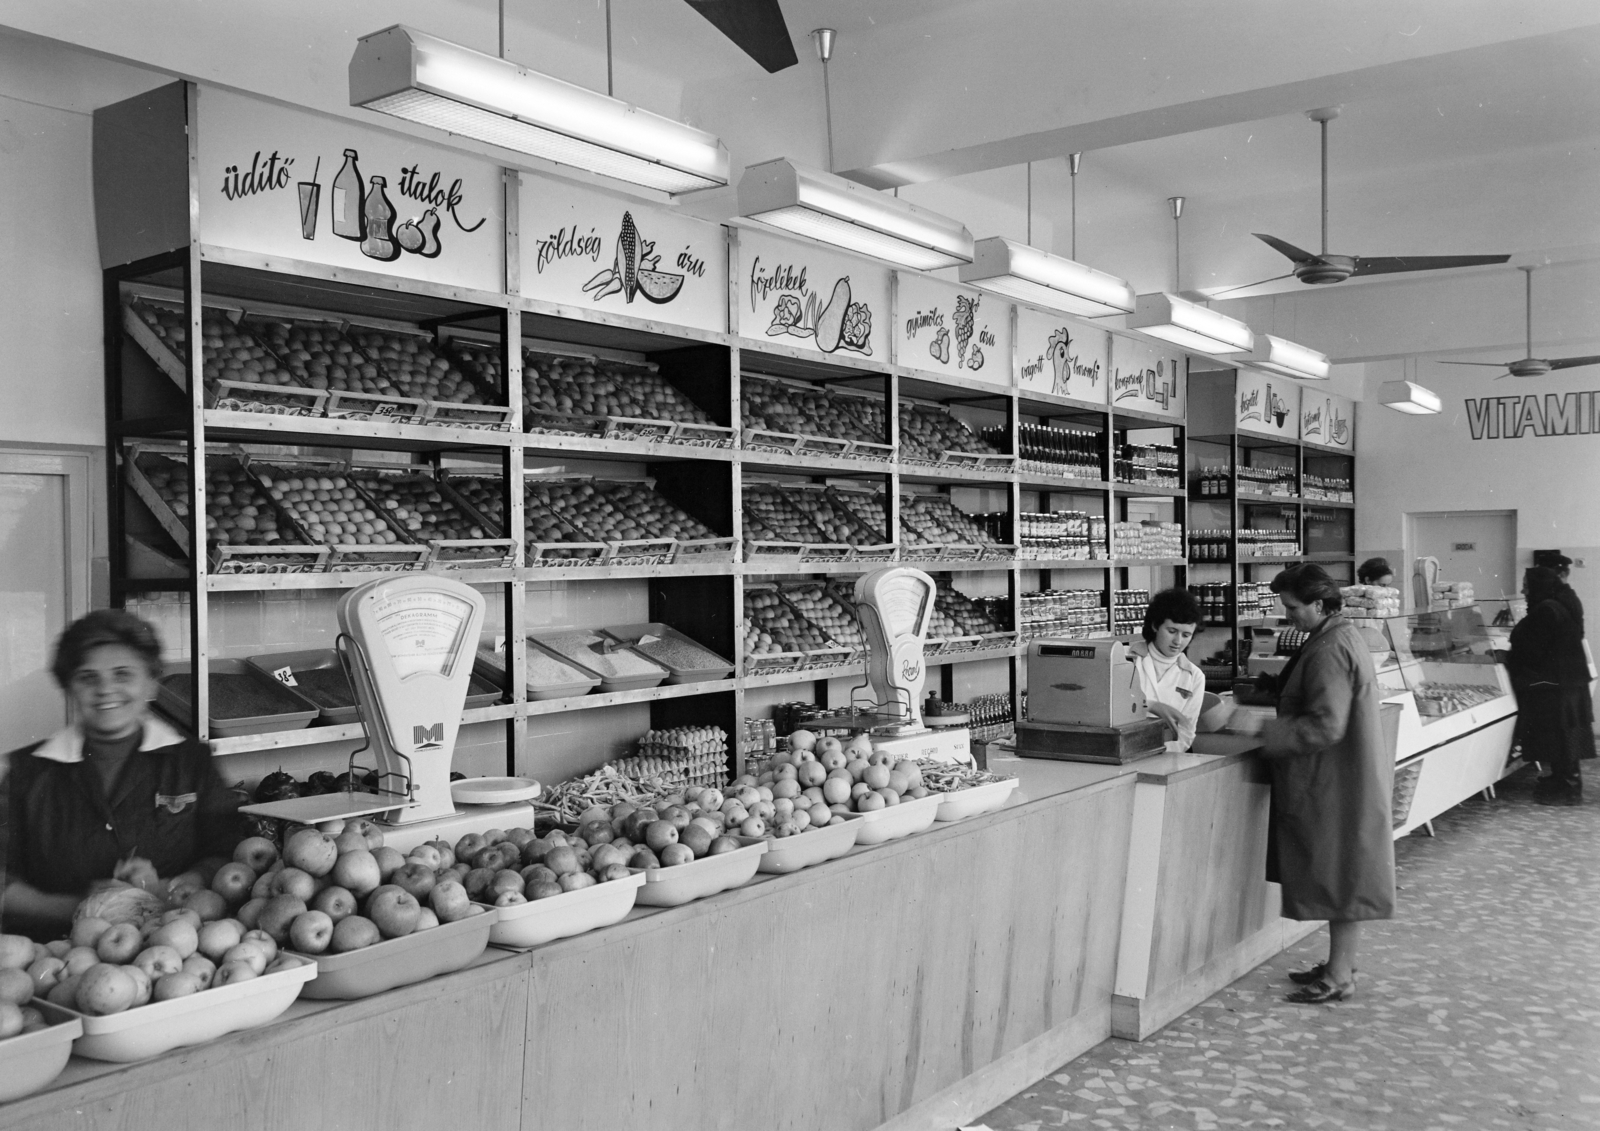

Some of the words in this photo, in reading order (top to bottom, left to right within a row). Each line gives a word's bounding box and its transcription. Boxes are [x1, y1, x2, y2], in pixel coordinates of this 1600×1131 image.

[221, 151, 295, 201] üdítő
[398, 164, 486, 232] italok
[536, 225, 602, 274] zöldség
[677, 245, 706, 278] áru
[751, 256, 808, 313] főzelékek
[906, 307, 944, 340] gyümölcs
[979, 324, 996, 347] áru
[1021, 354, 1045, 381] vágott
[1073, 354, 1101, 387] baromfi
[1455, 543, 1474, 551] IRODA
[400, 612, 438, 620] DEKAGRAMM
